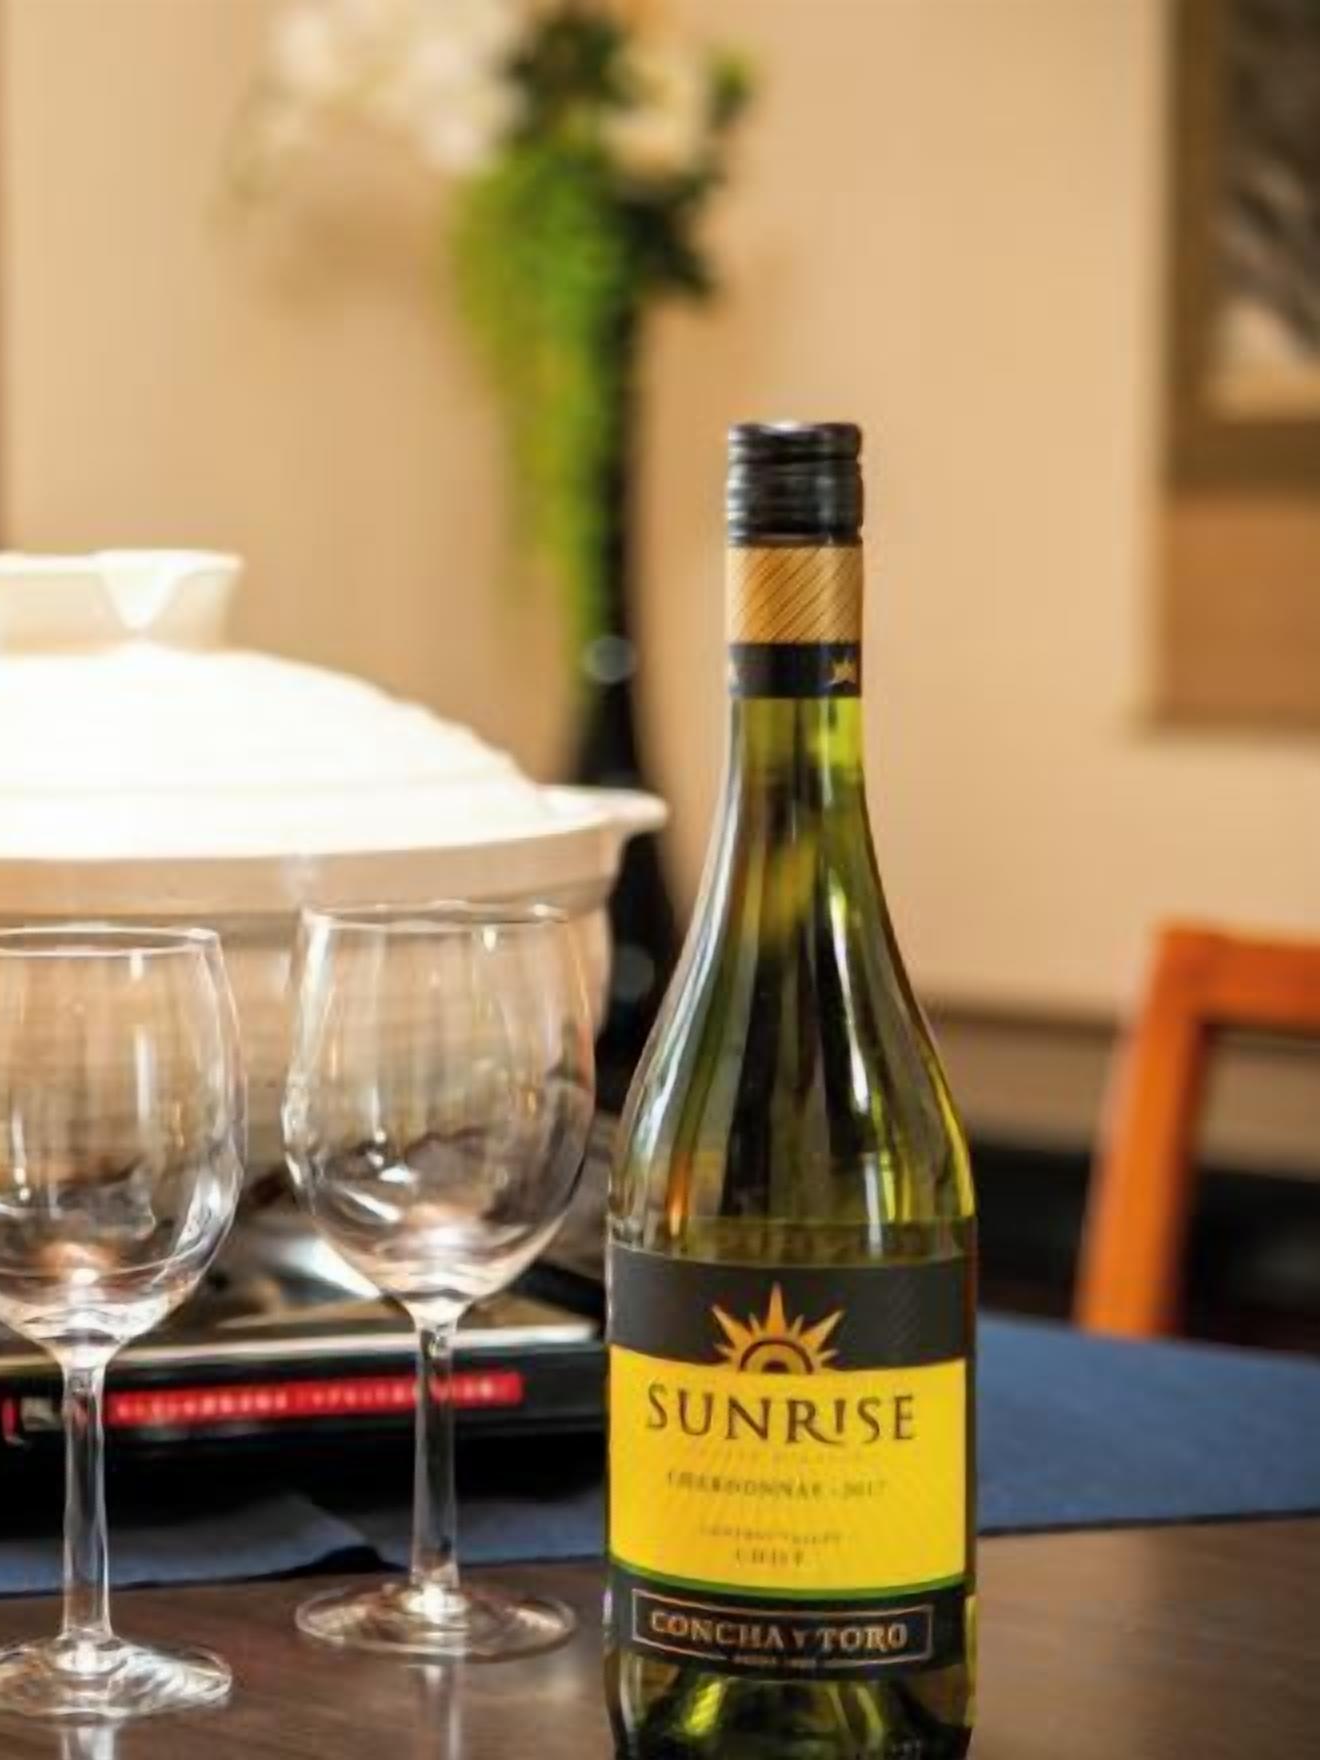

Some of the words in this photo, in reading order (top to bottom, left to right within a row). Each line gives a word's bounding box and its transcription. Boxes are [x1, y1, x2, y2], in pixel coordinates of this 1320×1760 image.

[646, 1382, 916, 1446] SUNRISE
[650, 1610, 784, 1649] CONCHA
[816, 1623, 908, 1653] TORO
